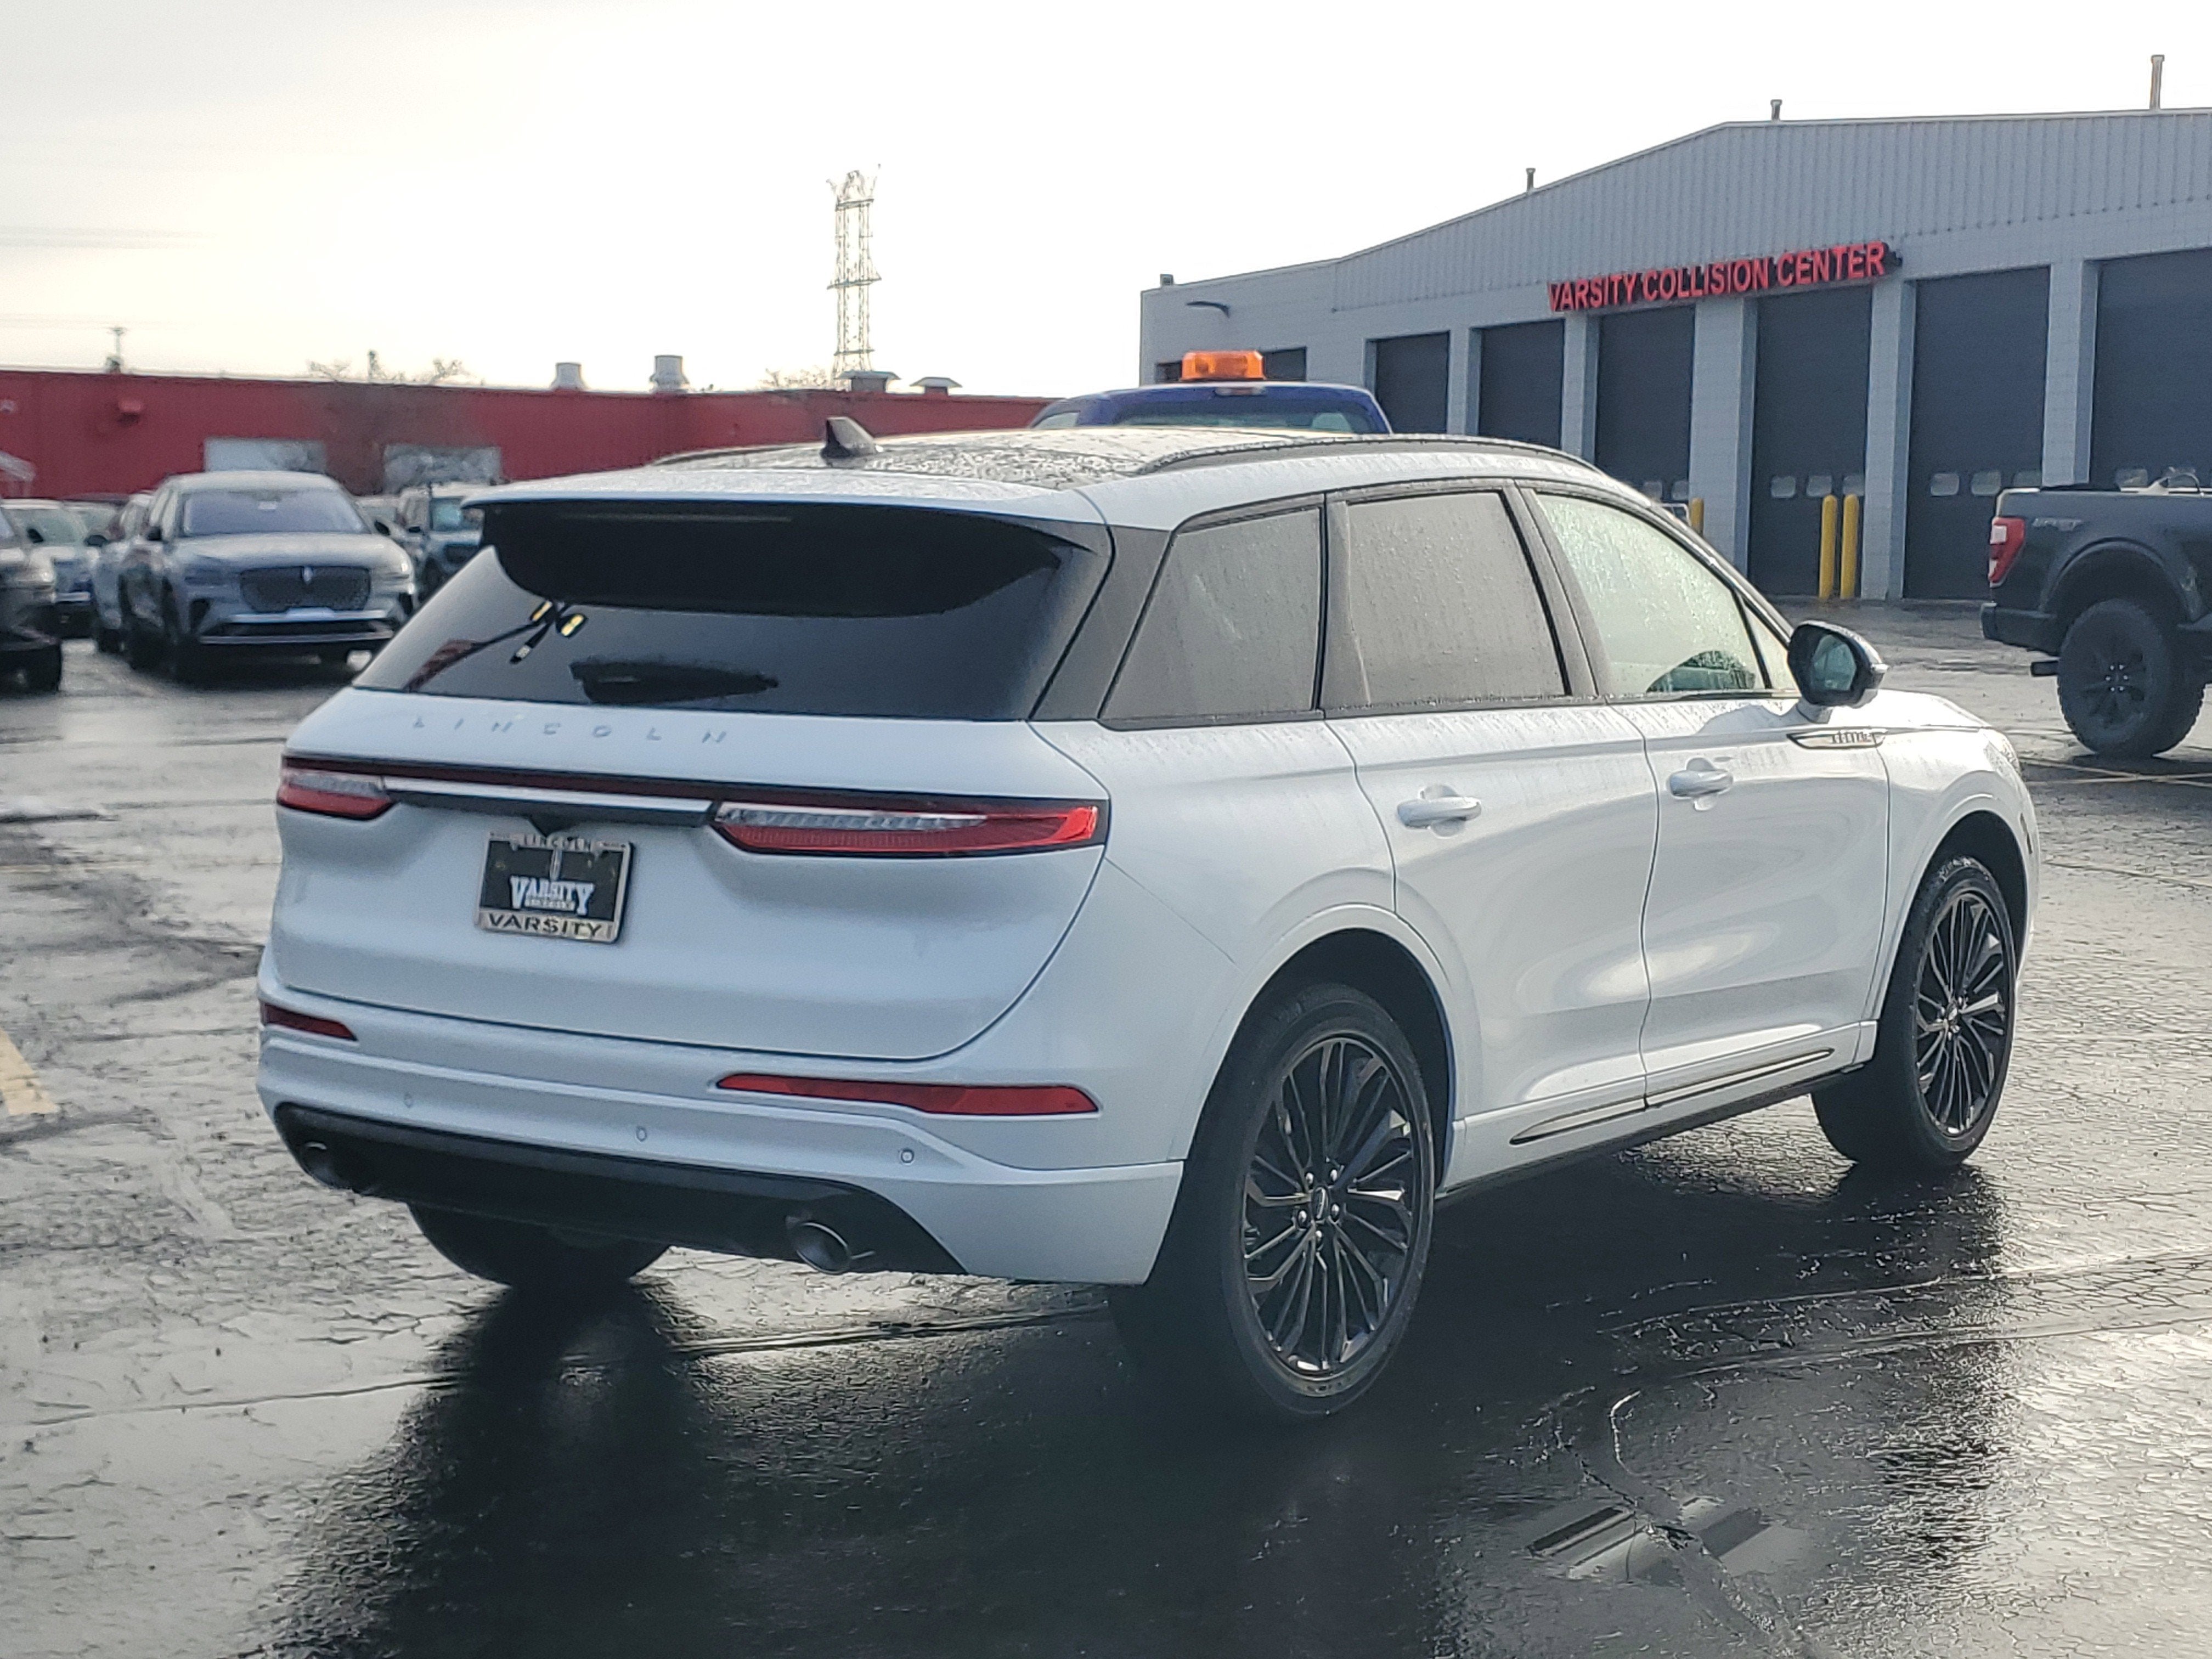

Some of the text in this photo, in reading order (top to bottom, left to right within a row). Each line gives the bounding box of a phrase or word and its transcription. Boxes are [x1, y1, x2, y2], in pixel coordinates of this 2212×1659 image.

[1548, 241, 1886, 312] VARSITY COLLISION CENTER
[413, 718, 727, 744] LINCOLN
[510, 875, 595, 916] VARSITY
[488, 912, 602, 937] VARSITY
